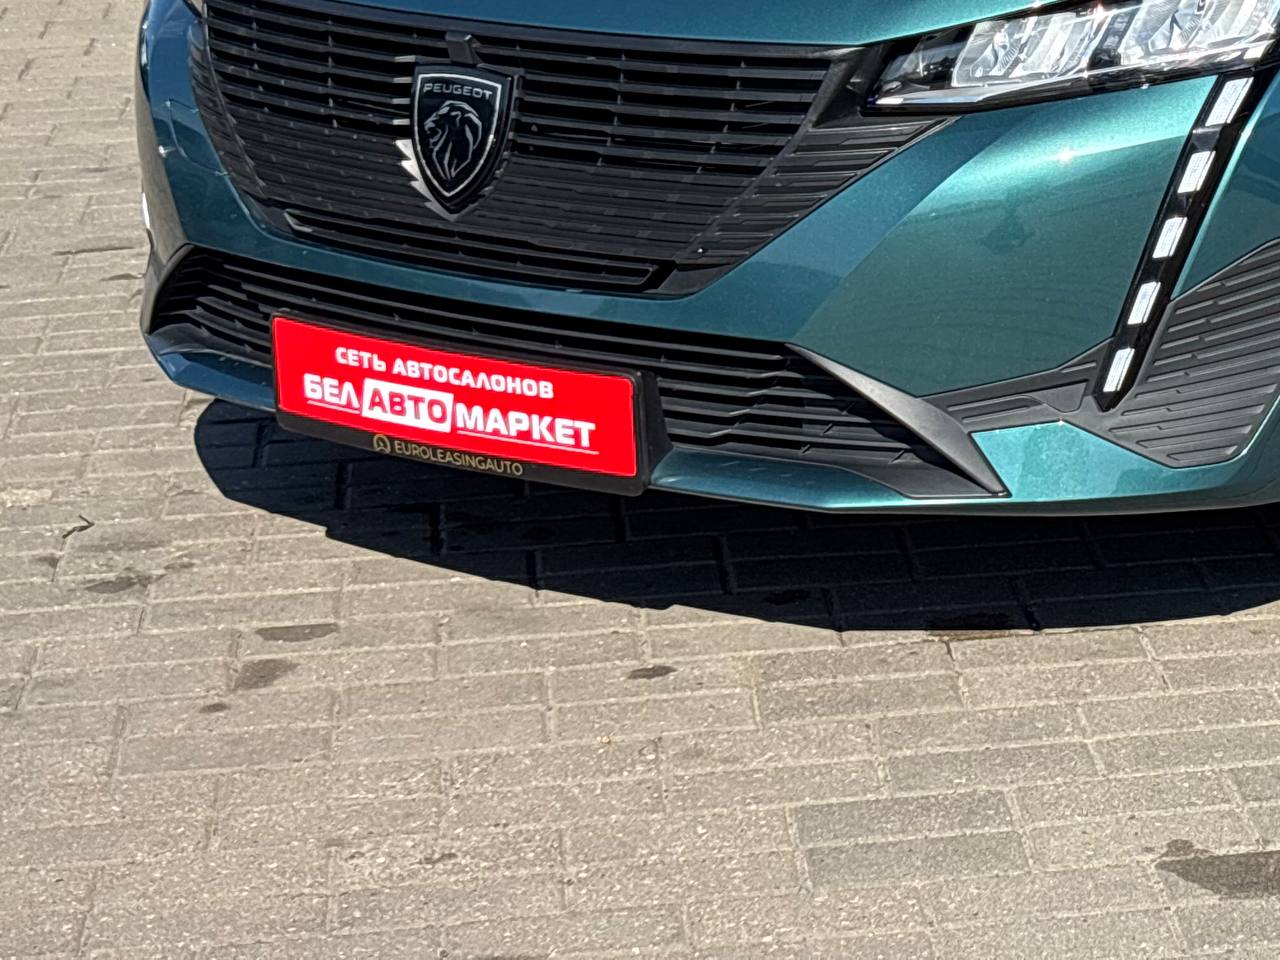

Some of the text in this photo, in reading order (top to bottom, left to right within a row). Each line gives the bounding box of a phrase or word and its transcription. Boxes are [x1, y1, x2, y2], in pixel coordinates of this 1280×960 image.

[423, 83, 493, 99] PEUGEOT
[335, 346, 554, 399] СЕТЬ АВТОСАЛОНОВ
[394, 439, 524, 476] EUROLEASINGAUTO
